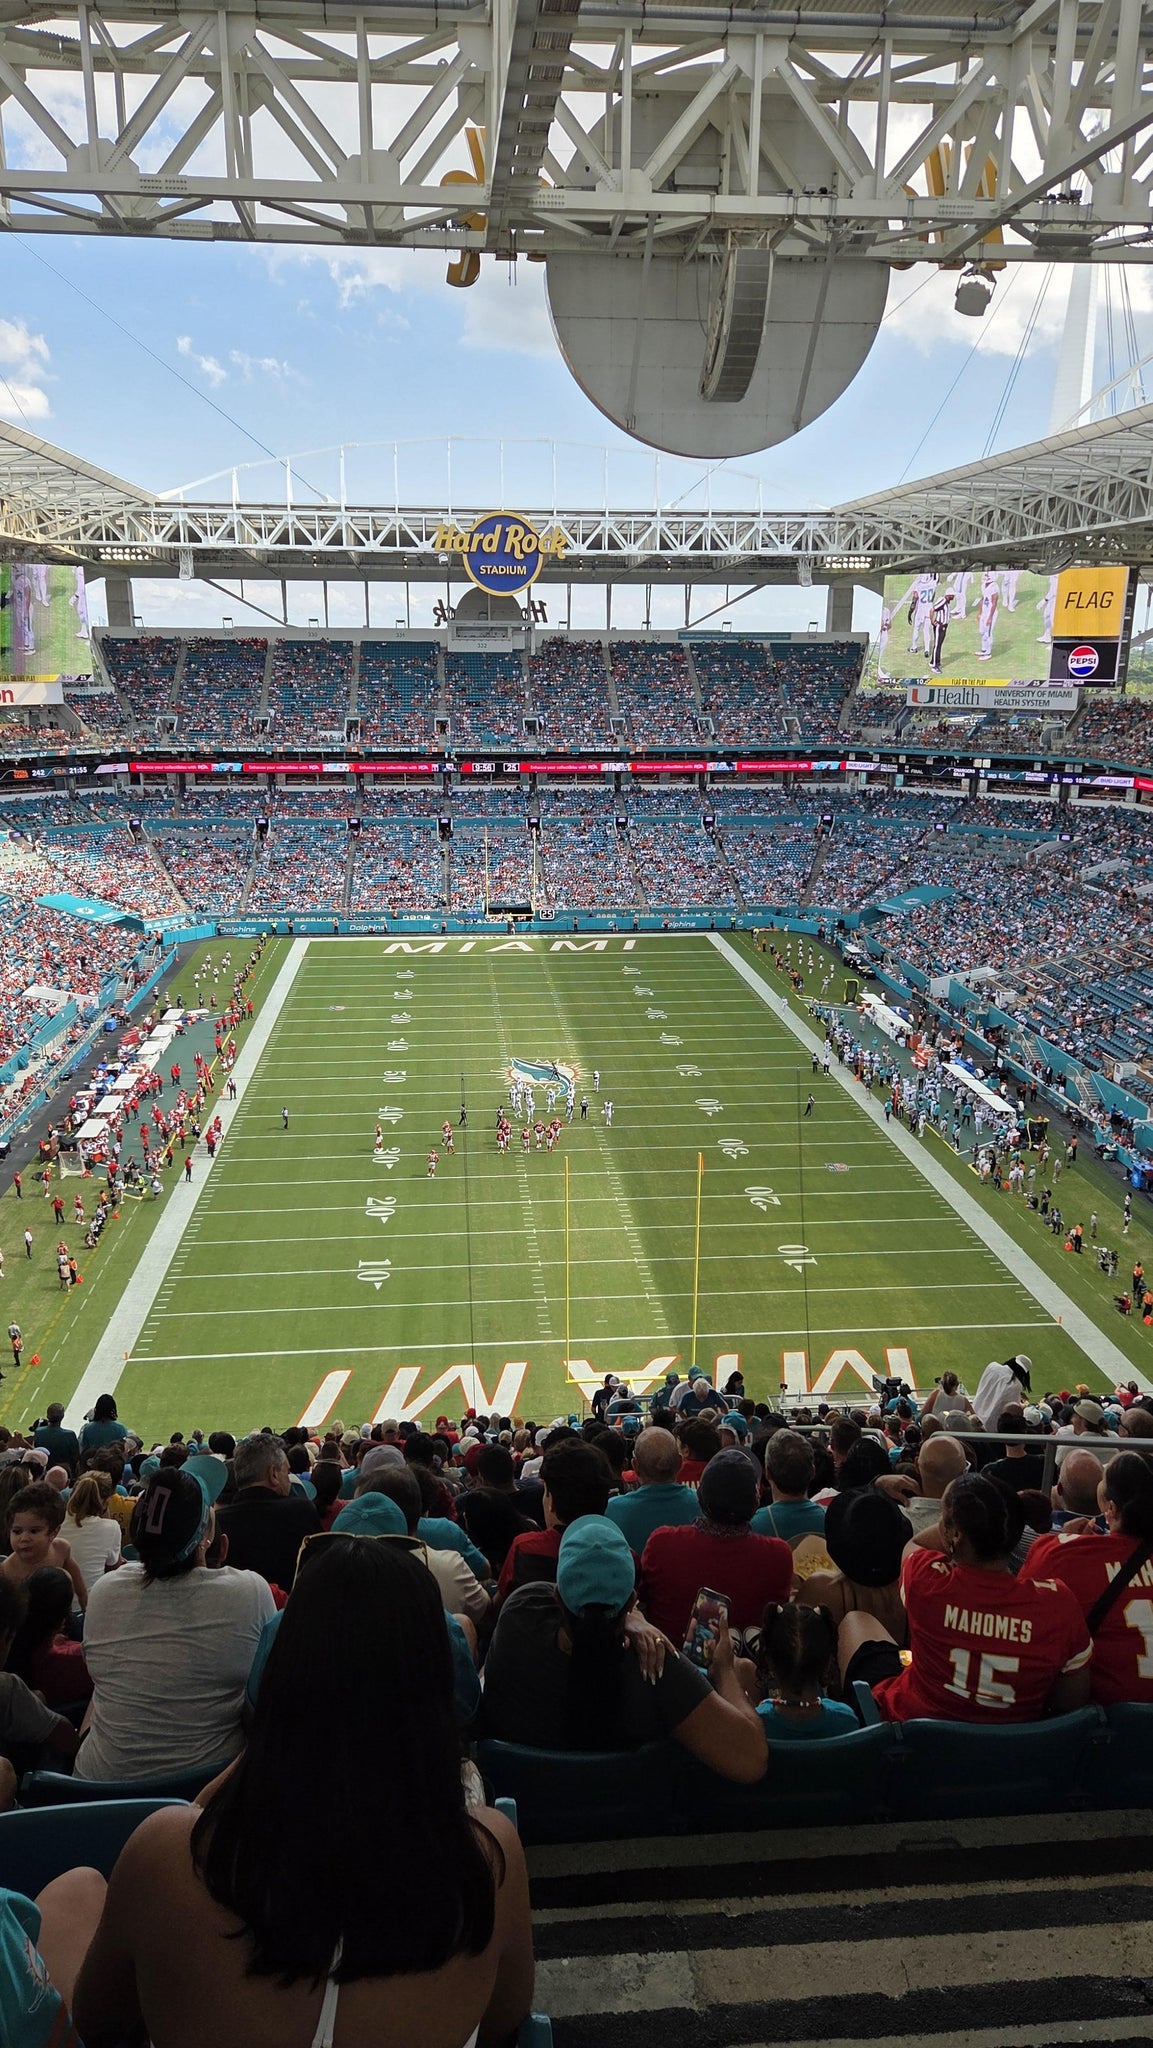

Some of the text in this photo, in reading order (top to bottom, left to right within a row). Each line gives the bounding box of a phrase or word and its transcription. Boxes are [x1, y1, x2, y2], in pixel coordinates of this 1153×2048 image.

[434, 523, 569, 560] Hard Rock
[479, 565, 527, 576] STADIUM
[1064, 591, 1114, 609] FLAG
[1070, 657, 1096, 666] PEPSI
[994, 690, 1072, 698] UNIVERSITY OF MIAMI
[1021, 699, 1050, 707] SYSTEM
[31, 769, 45, 777] 242
[474, 763, 492, 772] 9:56
[506, 763, 517, 772] 25
[542, 910, 552, 918] 25
[381, 938, 638, 954] MIAMI
[383, 1070, 407, 1083] 50
[676, 1064, 702, 1076] 50
[378, 1105, 404, 1120] 40
[694, 1098, 724, 1113] 40
[717, 1138, 749, 1155] 30
[744, 1186, 782, 1206] 20
[365, 1196, 397, 1217] 20
[777, 1244, 818, 1266] 10
[357, 1258, 391, 1282] 10
[943, 1603, 1033, 1644] MAHOMES
[943, 1647, 1020, 1709] 15
